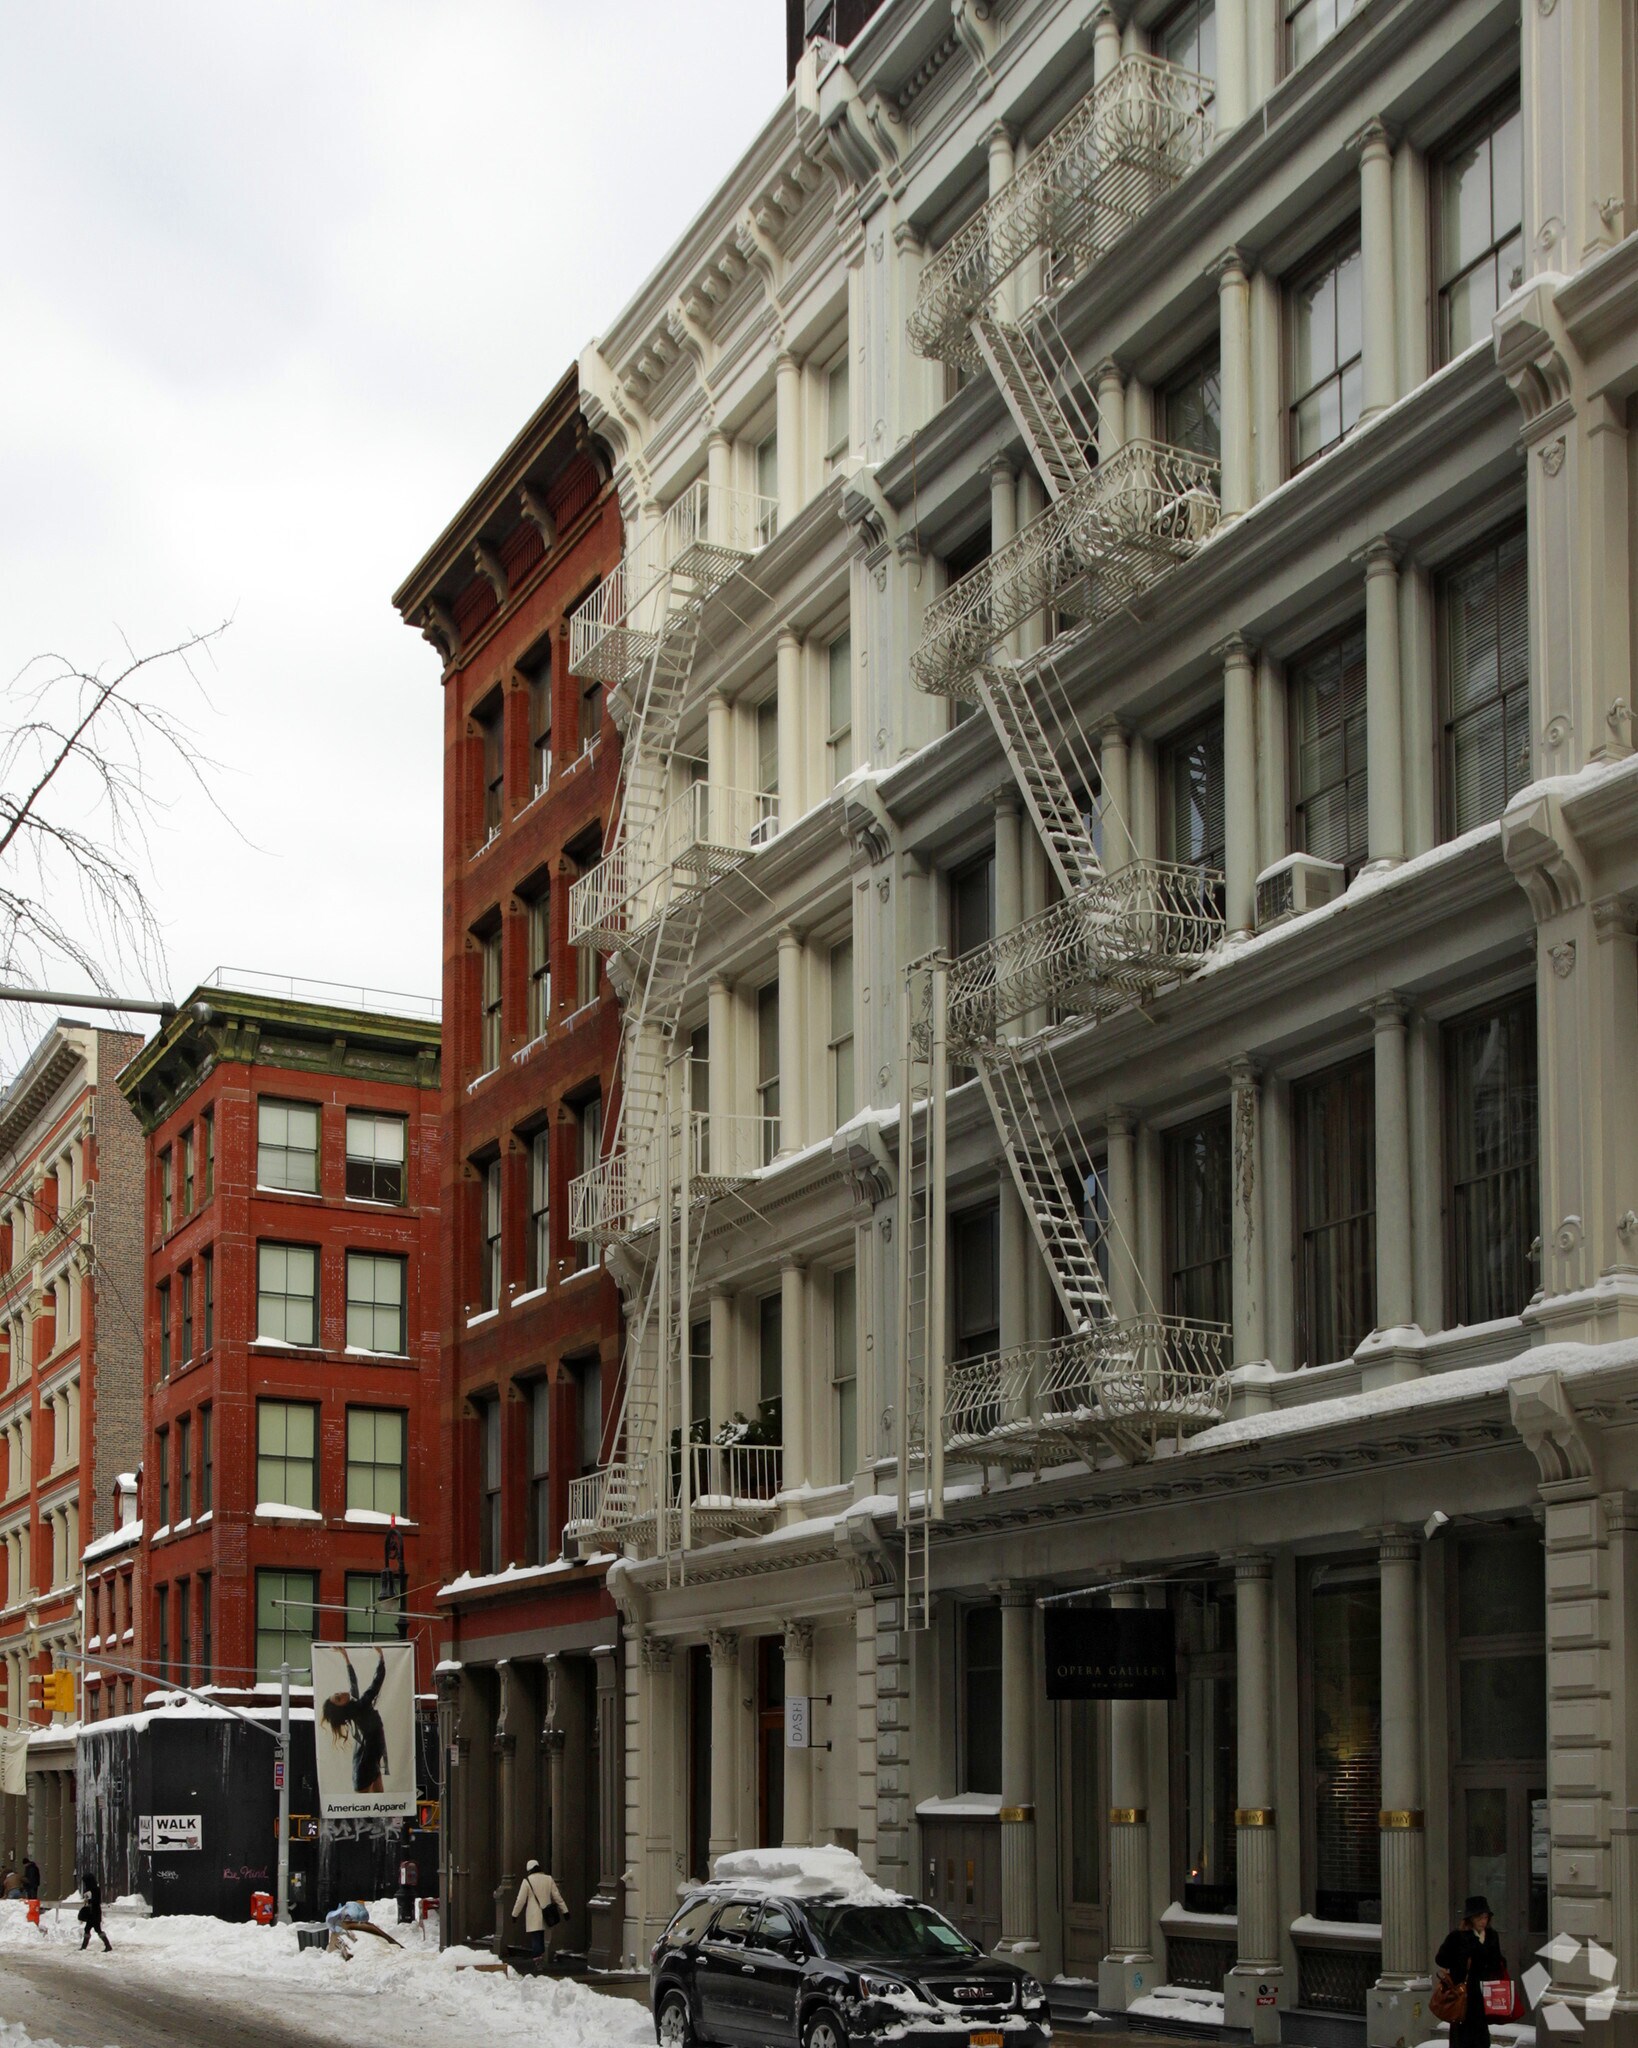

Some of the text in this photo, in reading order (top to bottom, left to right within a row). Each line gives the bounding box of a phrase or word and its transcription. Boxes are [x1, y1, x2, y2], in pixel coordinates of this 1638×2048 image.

[1057, 1665, 1102, 1677] OPERA
[792, 1702, 803, 1742] DASH
[327, 1802, 407, 1813] American Apparel
[157, 1818, 197, 1830] WALK
[957, 1987, 994, 1999] GMC
